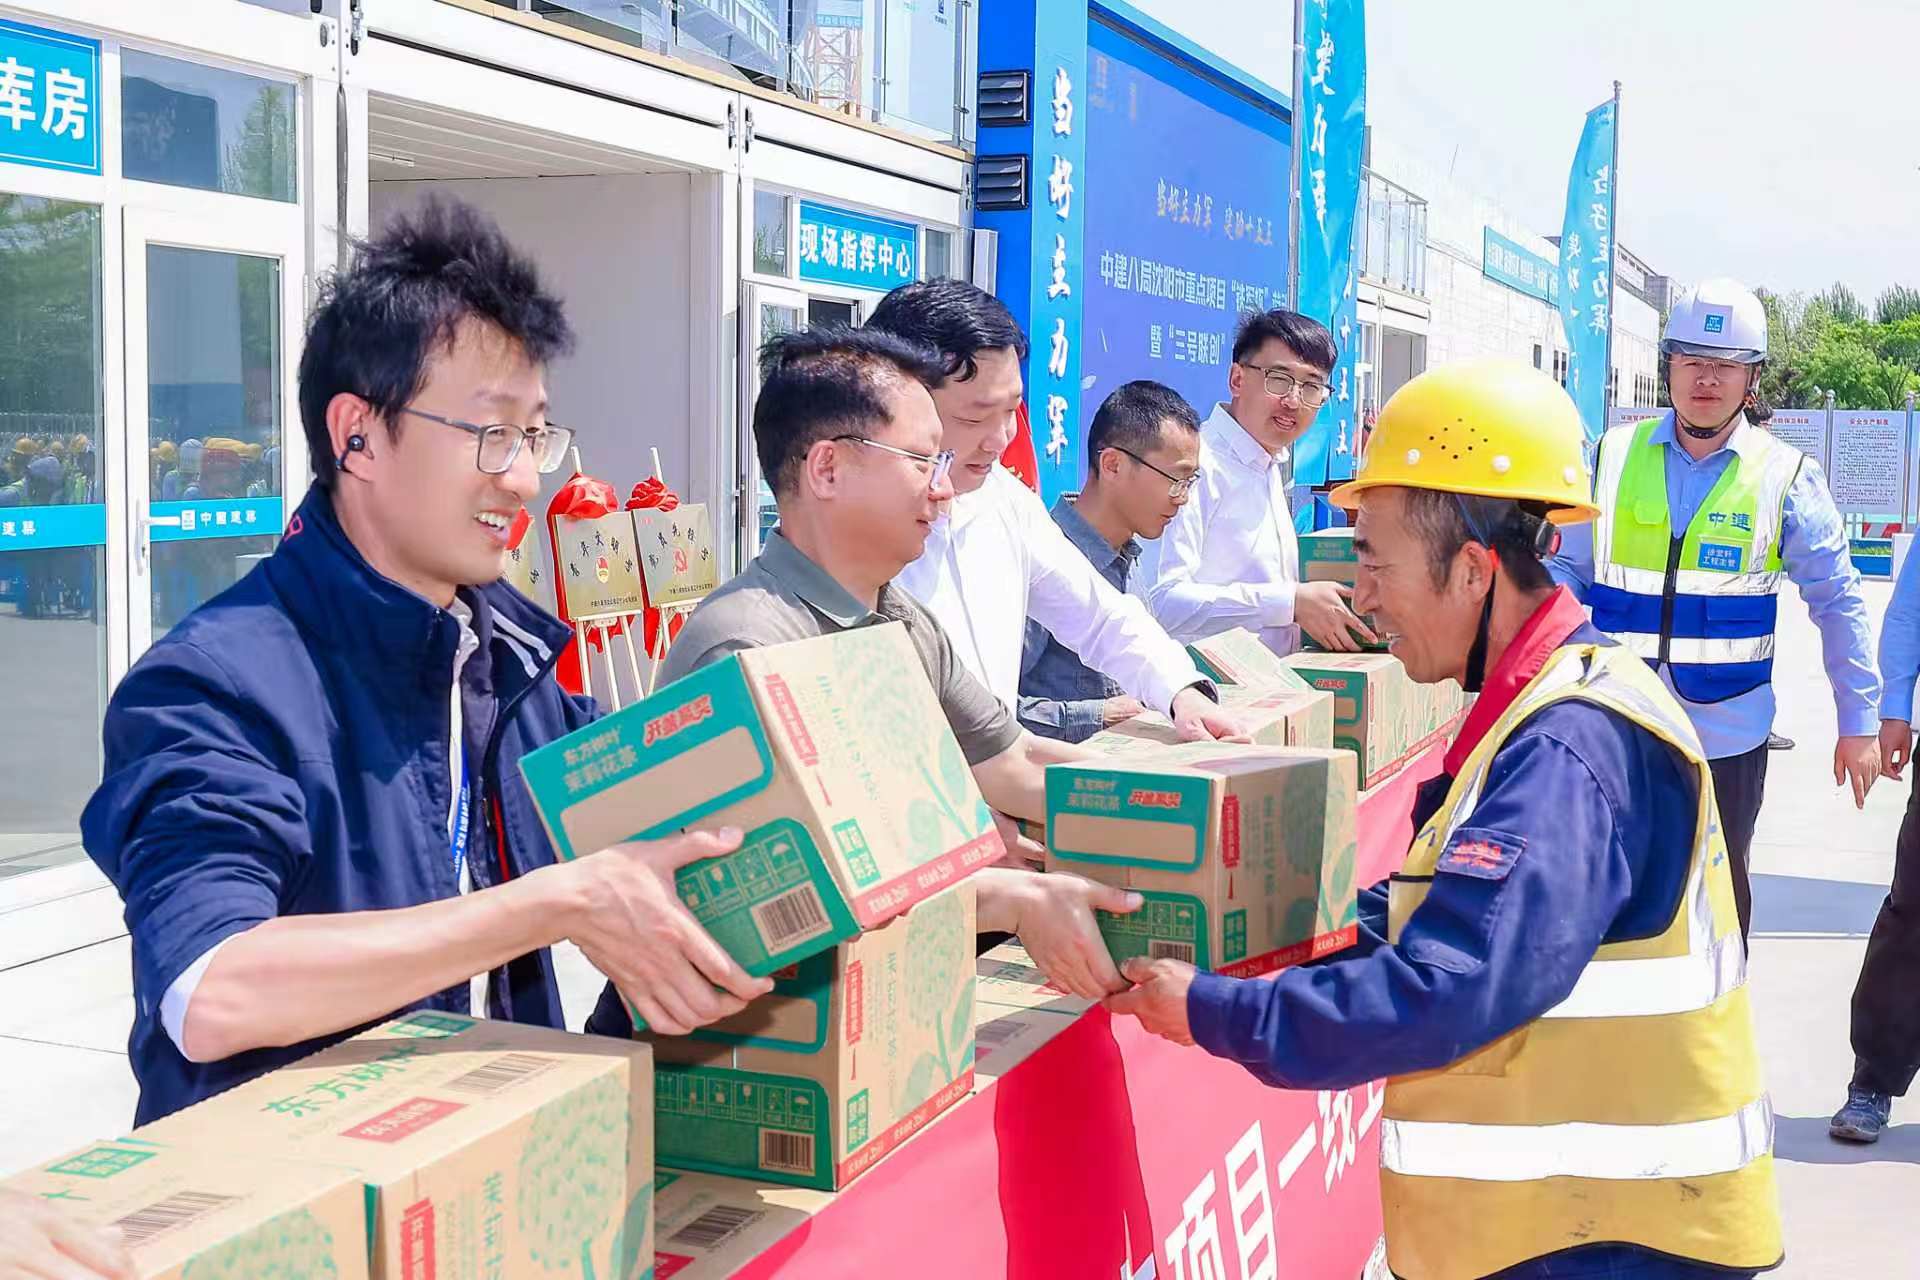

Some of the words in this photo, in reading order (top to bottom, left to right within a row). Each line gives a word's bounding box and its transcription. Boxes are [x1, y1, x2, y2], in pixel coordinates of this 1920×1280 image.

[800, 223, 911, 279] 现场指挥中心
[1047, 65, 1073, 466] 当好主力军
[1157, 177, 1214, 230] 当好主力军
[1120, 1082, 1385, 1280] 项目一线
